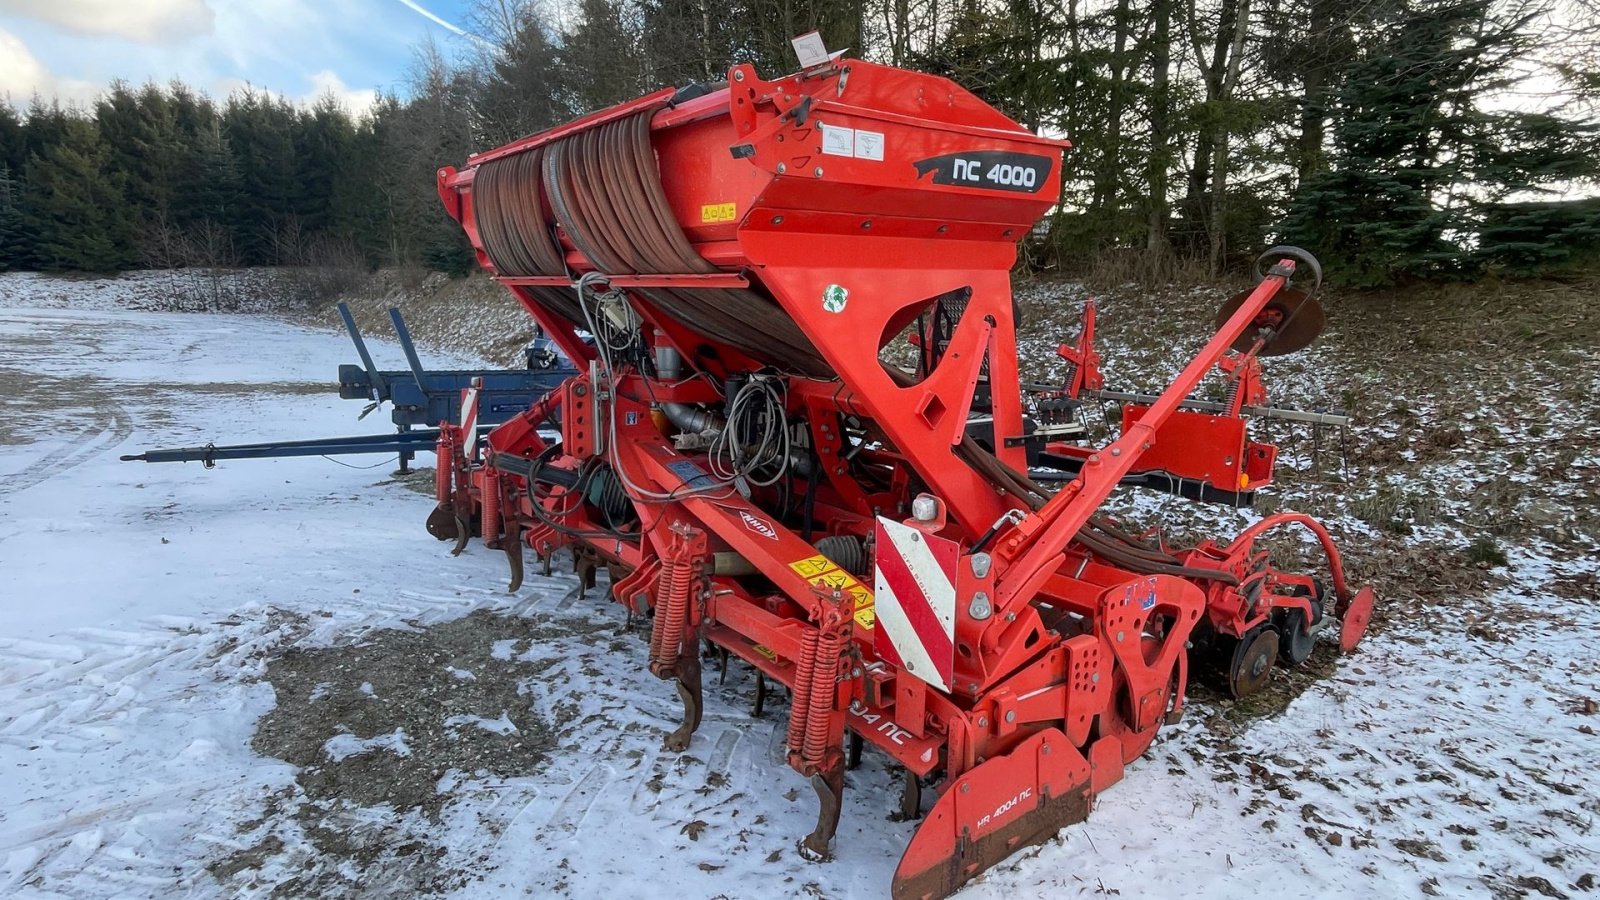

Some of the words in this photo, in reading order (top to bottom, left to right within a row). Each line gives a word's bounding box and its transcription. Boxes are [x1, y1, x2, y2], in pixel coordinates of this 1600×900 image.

[986, 164, 1036, 187] 4000
[743, 514, 775, 537] KUHN
[977, 814, 990, 830] HR
[993, 796, 1017, 817] 4004
